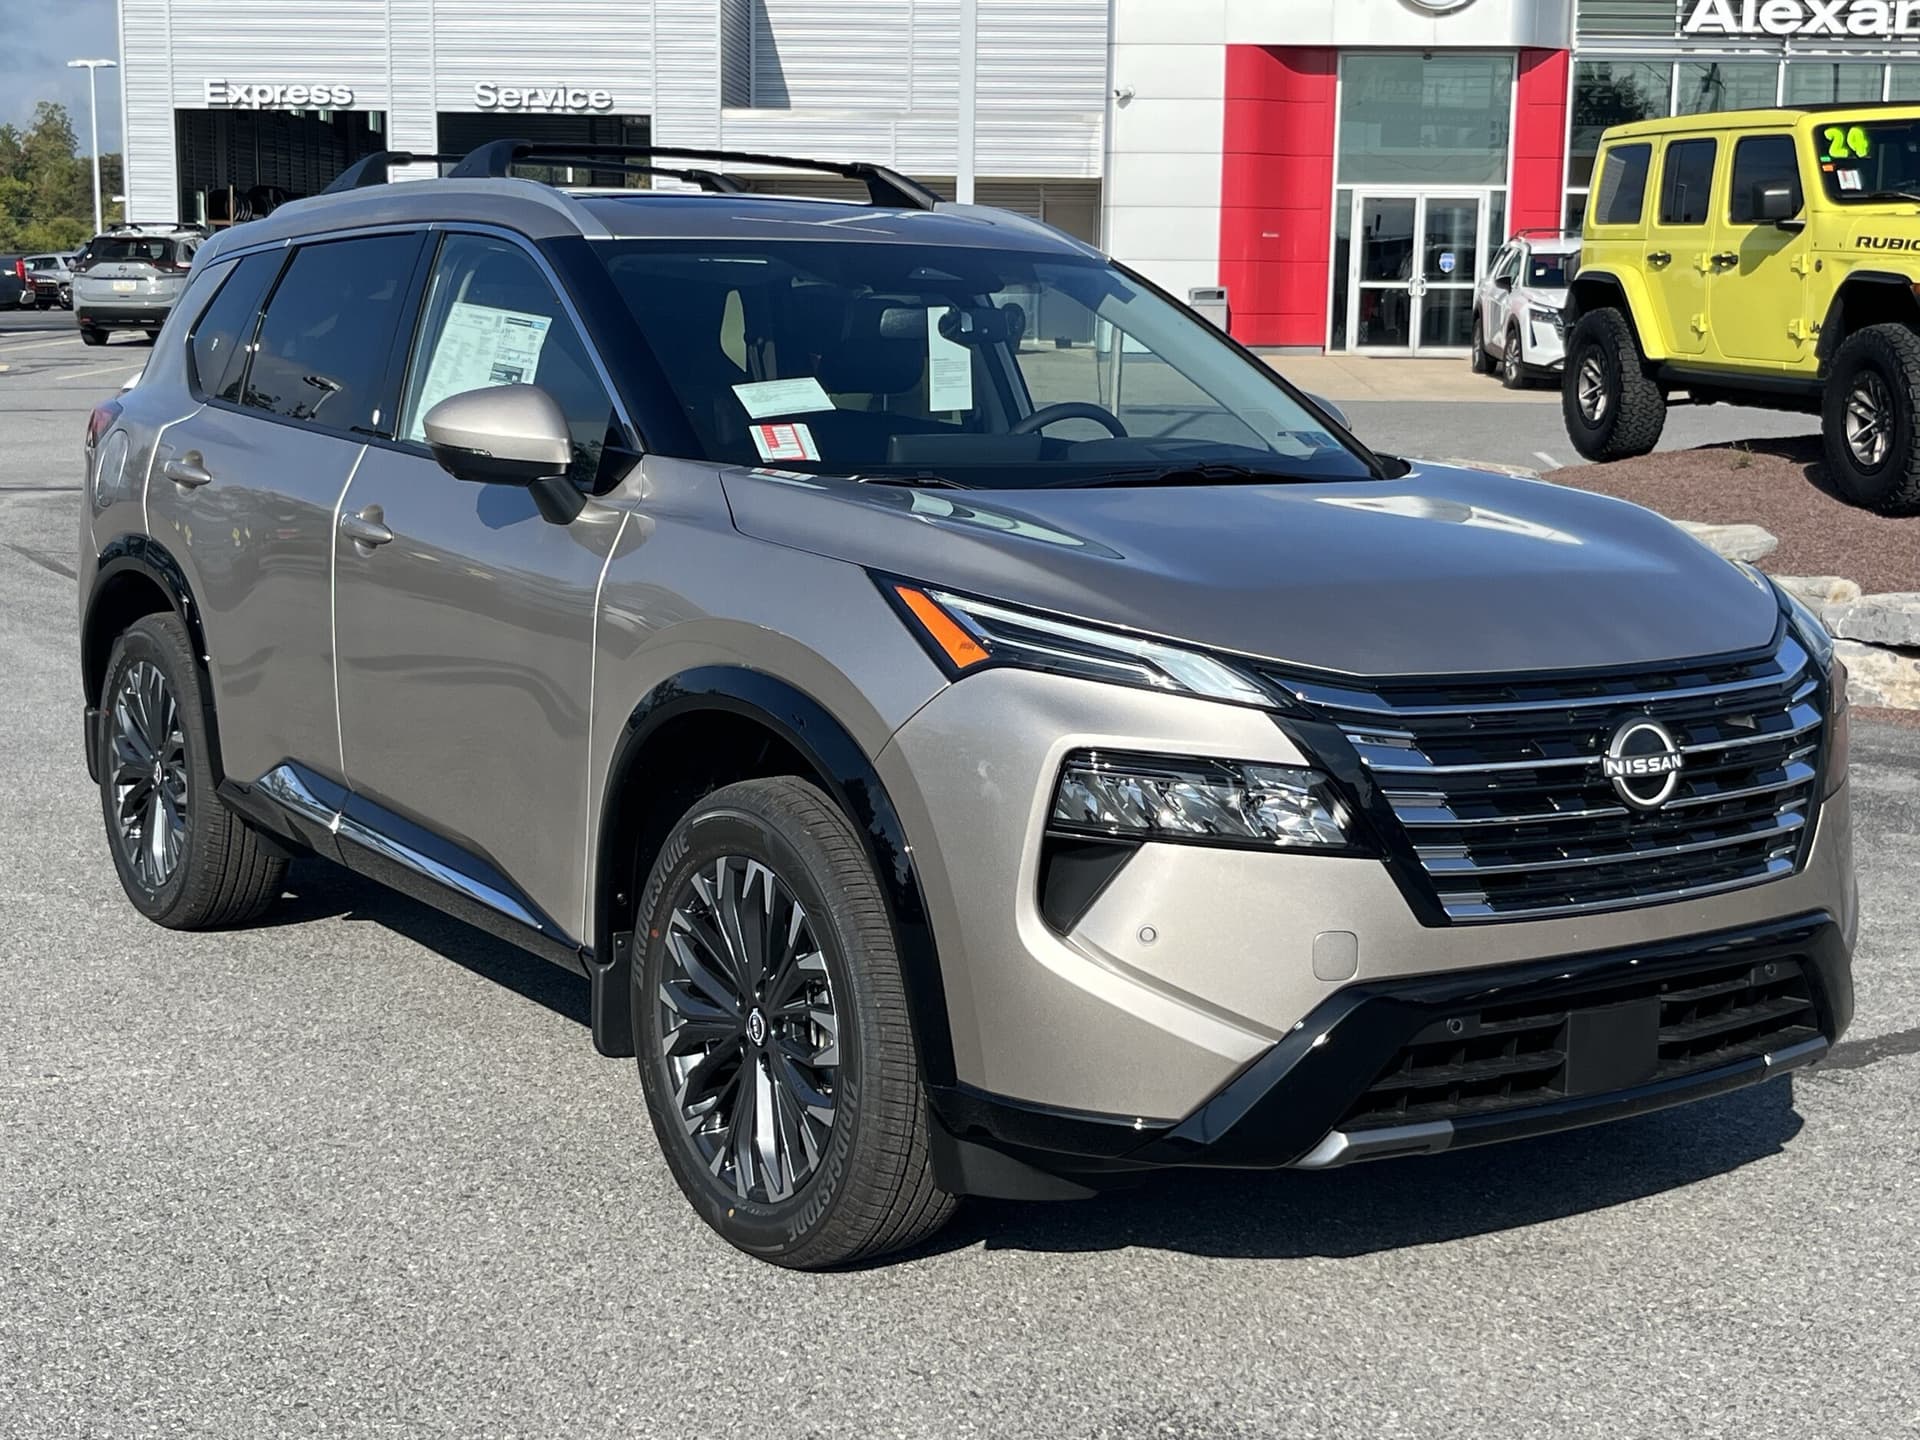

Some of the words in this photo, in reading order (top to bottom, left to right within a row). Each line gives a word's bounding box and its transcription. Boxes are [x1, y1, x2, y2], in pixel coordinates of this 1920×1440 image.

[204, 79, 354, 109] Express
[474, 81, 613, 109] Service
[1824, 127, 1868, 158] 24
[1606, 754, 1682, 775] NISSAN
[630, 829, 691, 991] BRIDGESTONE
